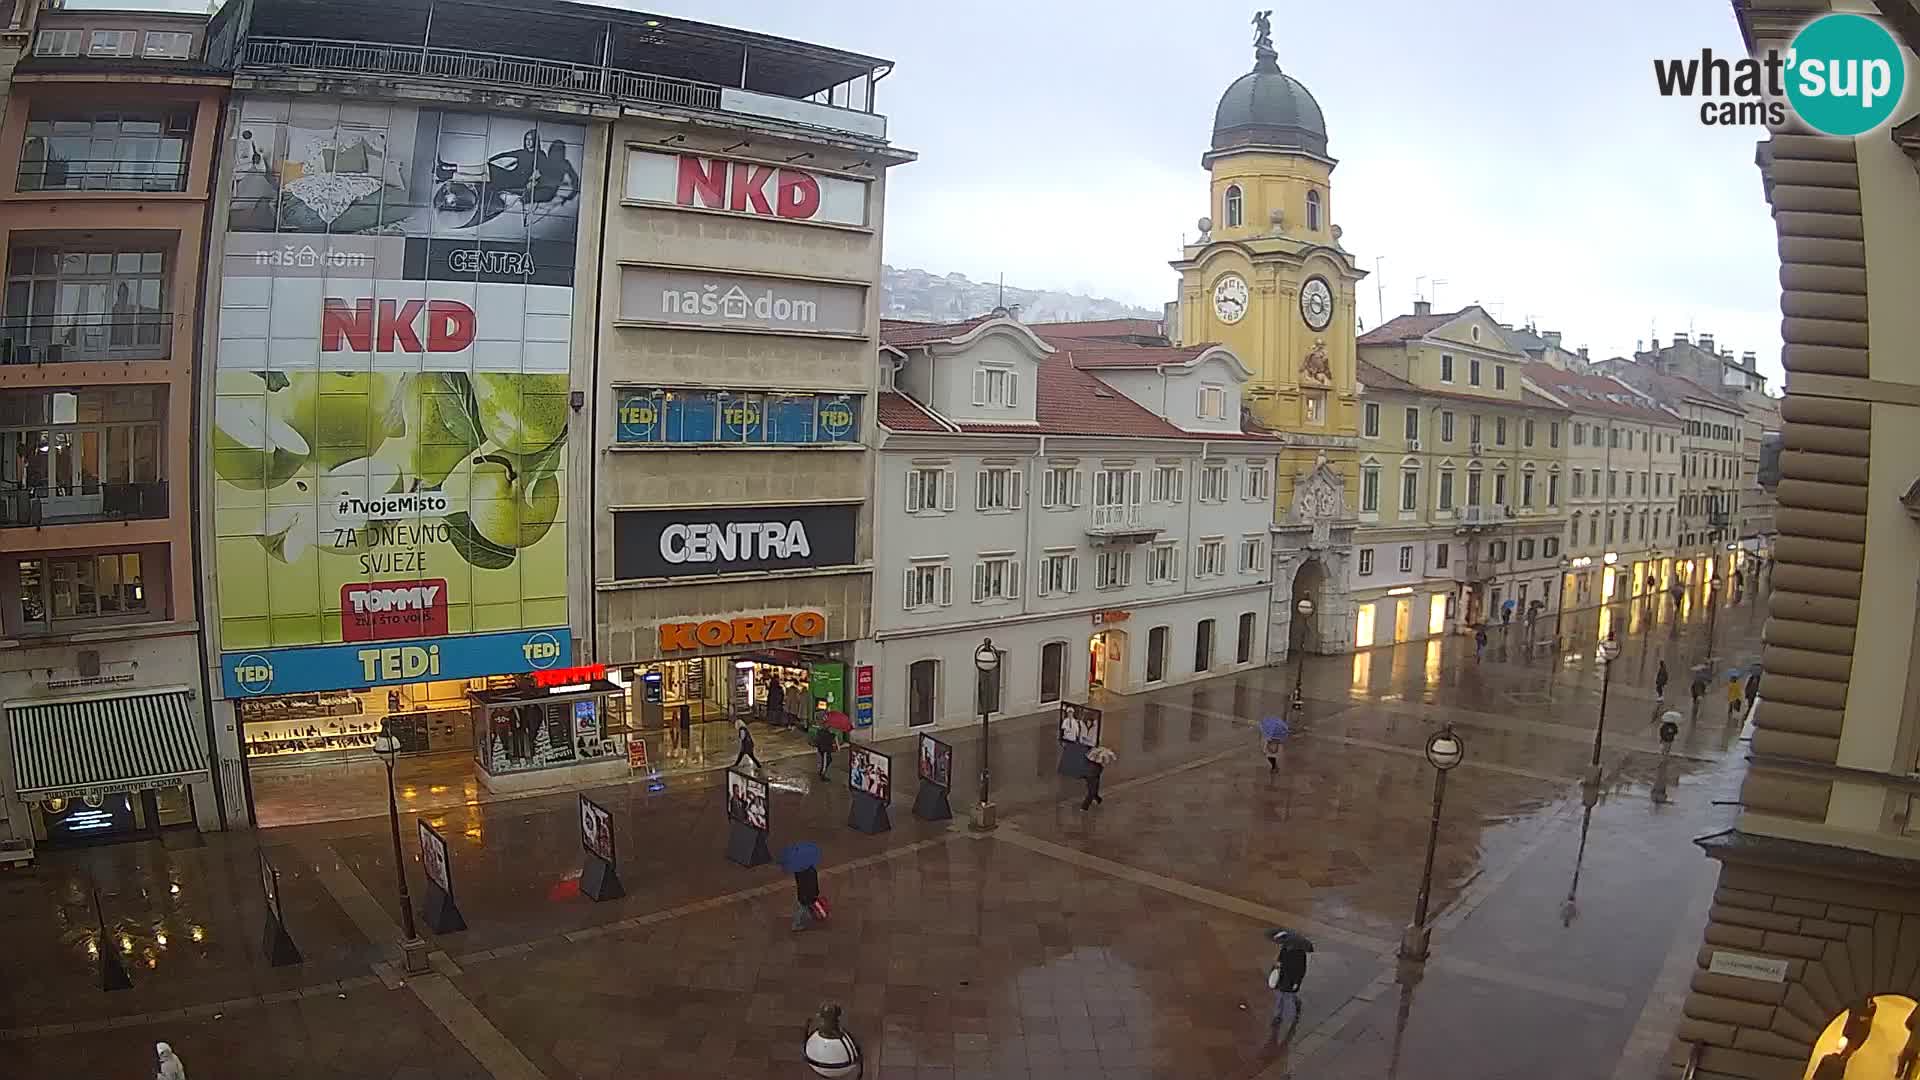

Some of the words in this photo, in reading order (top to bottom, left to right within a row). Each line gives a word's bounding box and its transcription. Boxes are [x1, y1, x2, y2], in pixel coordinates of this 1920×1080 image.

[676, 154, 821, 220] NKD
[256, 245, 294, 267] naš
[319, 246, 365, 267] dom
[448, 249, 535, 276] CENTRA
[662, 284, 717, 315] naš
[754, 289, 817, 323] dom
[320, 297, 477, 354] NKD
[339, 496, 446, 516] #TvojeMisto
[334, 528, 357, 548] ZA
[367, 523, 451, 547] DNEVNO
[660, 520, 811, 563] CENTRA
[360, 547, 426, 574] SVJEŽE
[349, 586, 440, 613] TOMMY
[380, 612, 401, 625] ŠTO
[659, 611, 825, 652] KORZO
[359, 645, 440, 682] TEDi
[523, 641, 560, 662] TEDi
[235, 665, 273, 683] TEDi
